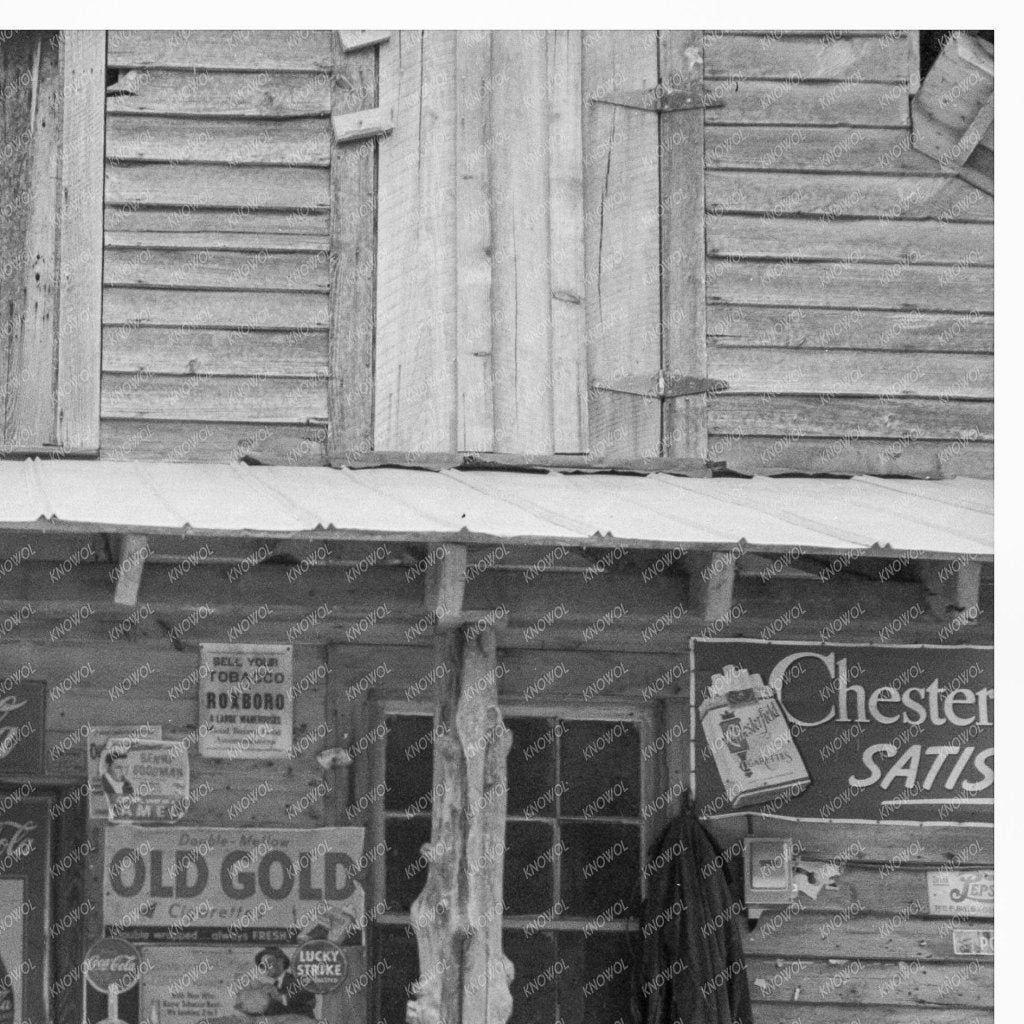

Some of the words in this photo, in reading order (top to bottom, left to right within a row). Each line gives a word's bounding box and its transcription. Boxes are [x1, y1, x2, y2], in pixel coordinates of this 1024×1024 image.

[212, 657, 243, 667] SELL
[247, 657, 279, 667] YOUR
[208, 670, 285, 684] TOBACCO
[206, 692, 285, 710] ROXBORO
[119, 803, 177, 817] AMEL
[109, 847, 210, 900] OLD
[220, 849, 359, 901] GOLD
[167, 902, 266, 920] Cigarettes
[299, 949, 340, 963] LUCKY
[296, 963, 343, 976] STRIKE
